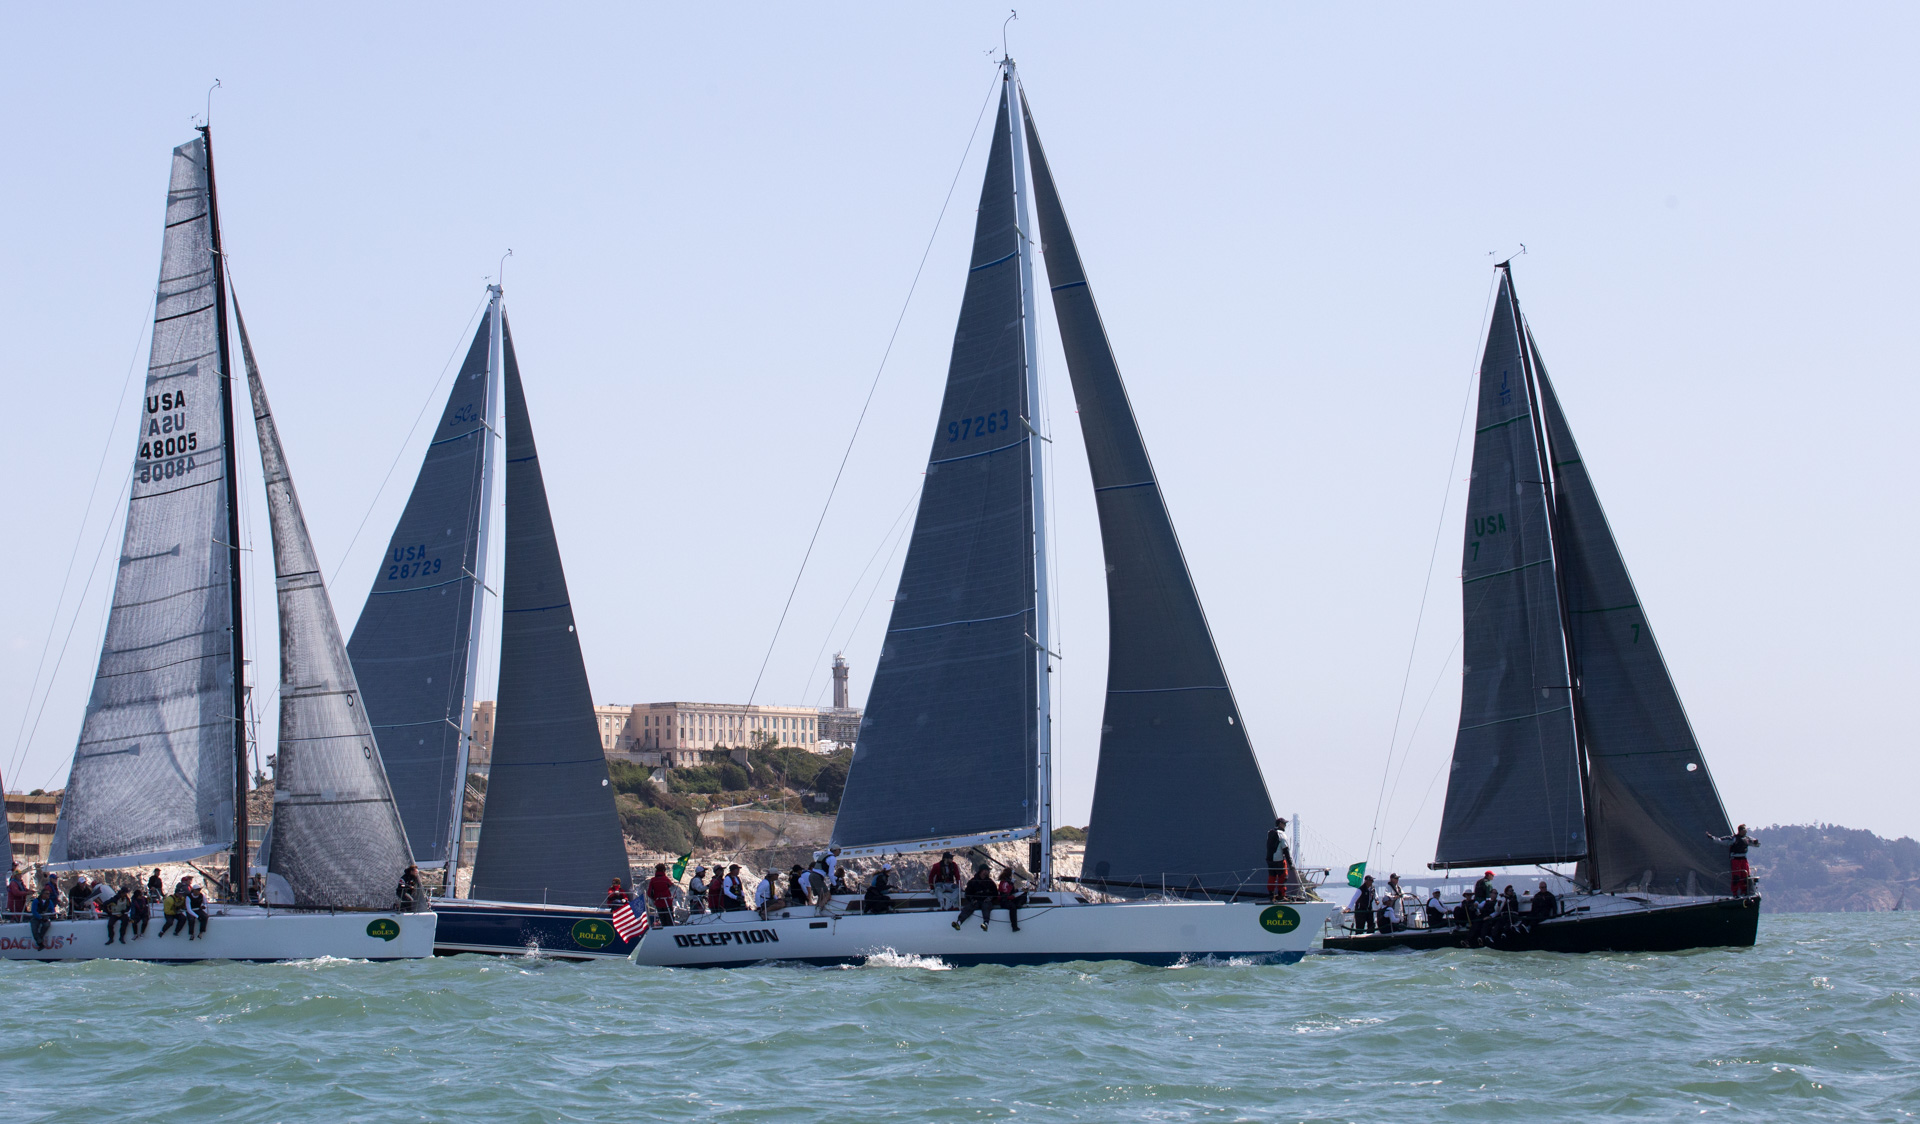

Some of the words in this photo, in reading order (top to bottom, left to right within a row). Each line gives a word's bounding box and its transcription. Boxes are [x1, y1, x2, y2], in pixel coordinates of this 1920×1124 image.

[147, 390, 185, 413] USA
[947, 409, 1008, 442] 97263
[140, 432, 197, 460] 48005
[1474, 513, 1506, 537] USA
[393, 544, 425, 562] USA
[1471, 541, 1480, 562] 7
[388, 558, 441, 580] 28729
[1631, 624, 1640, 644] 7
[579, 932, 607, 941] ROLEX
[673, 929, 779, 948] DECEPTION
